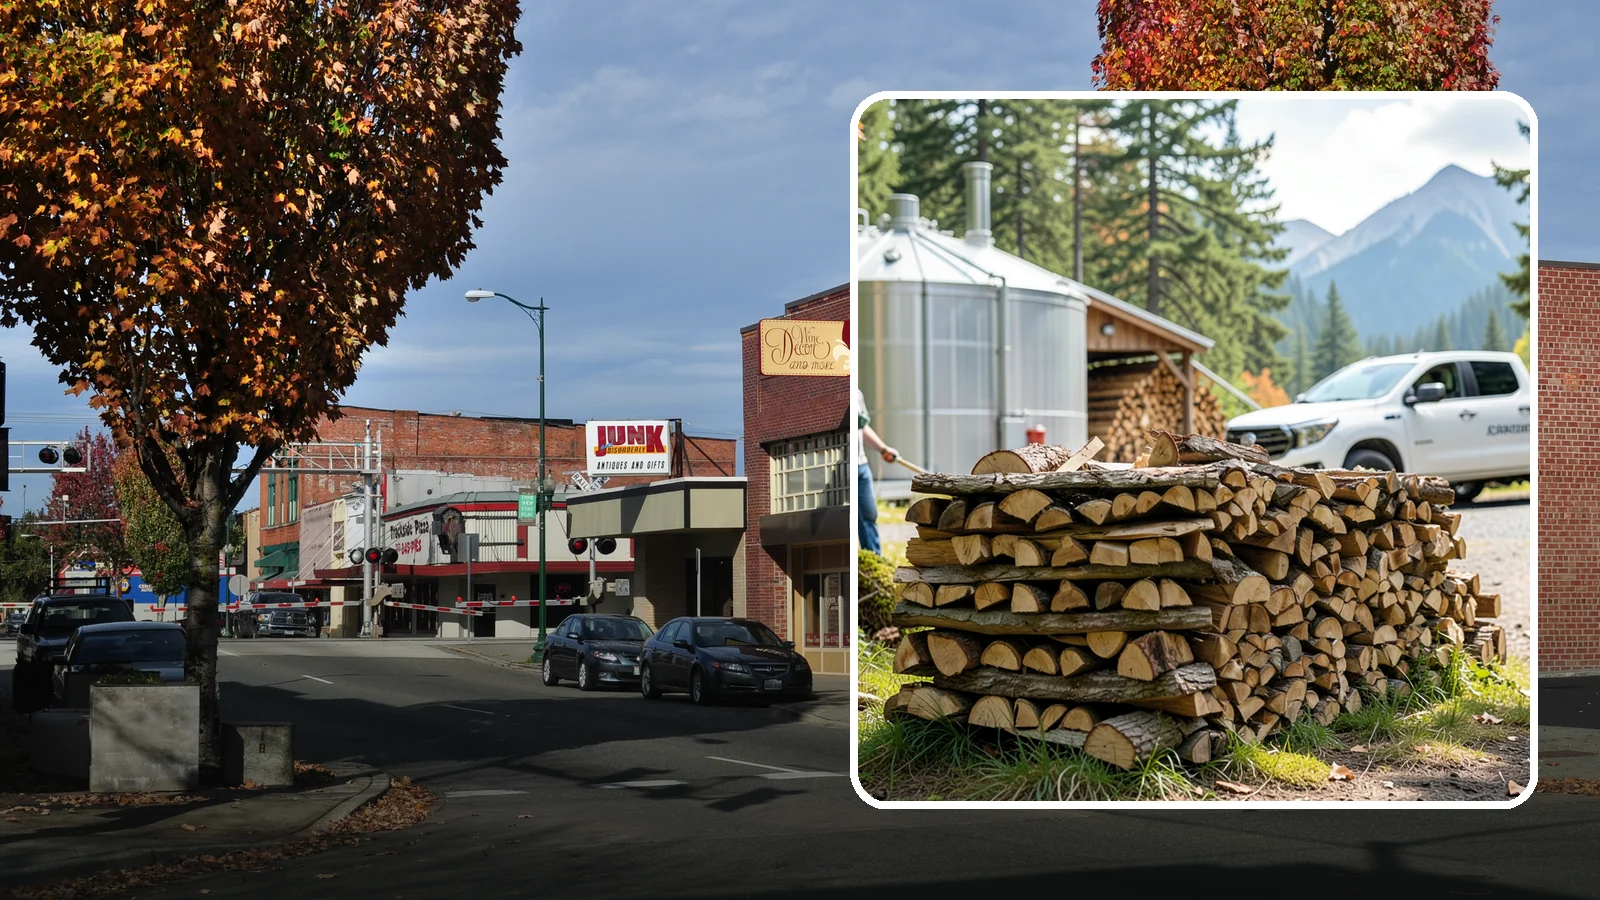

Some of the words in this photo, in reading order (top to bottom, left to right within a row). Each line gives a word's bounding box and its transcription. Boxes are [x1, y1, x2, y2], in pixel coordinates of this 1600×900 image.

[595, 425, 665, 457] JUNK
[608, 446, 646, 454] DISORDERLY
[597, 461, 628, 470] ANTIQUES
[631, 461, 644, 470] AND
[647, 460, 665, 469] GIFTS
[415, 519, 429, 535] Pizza
